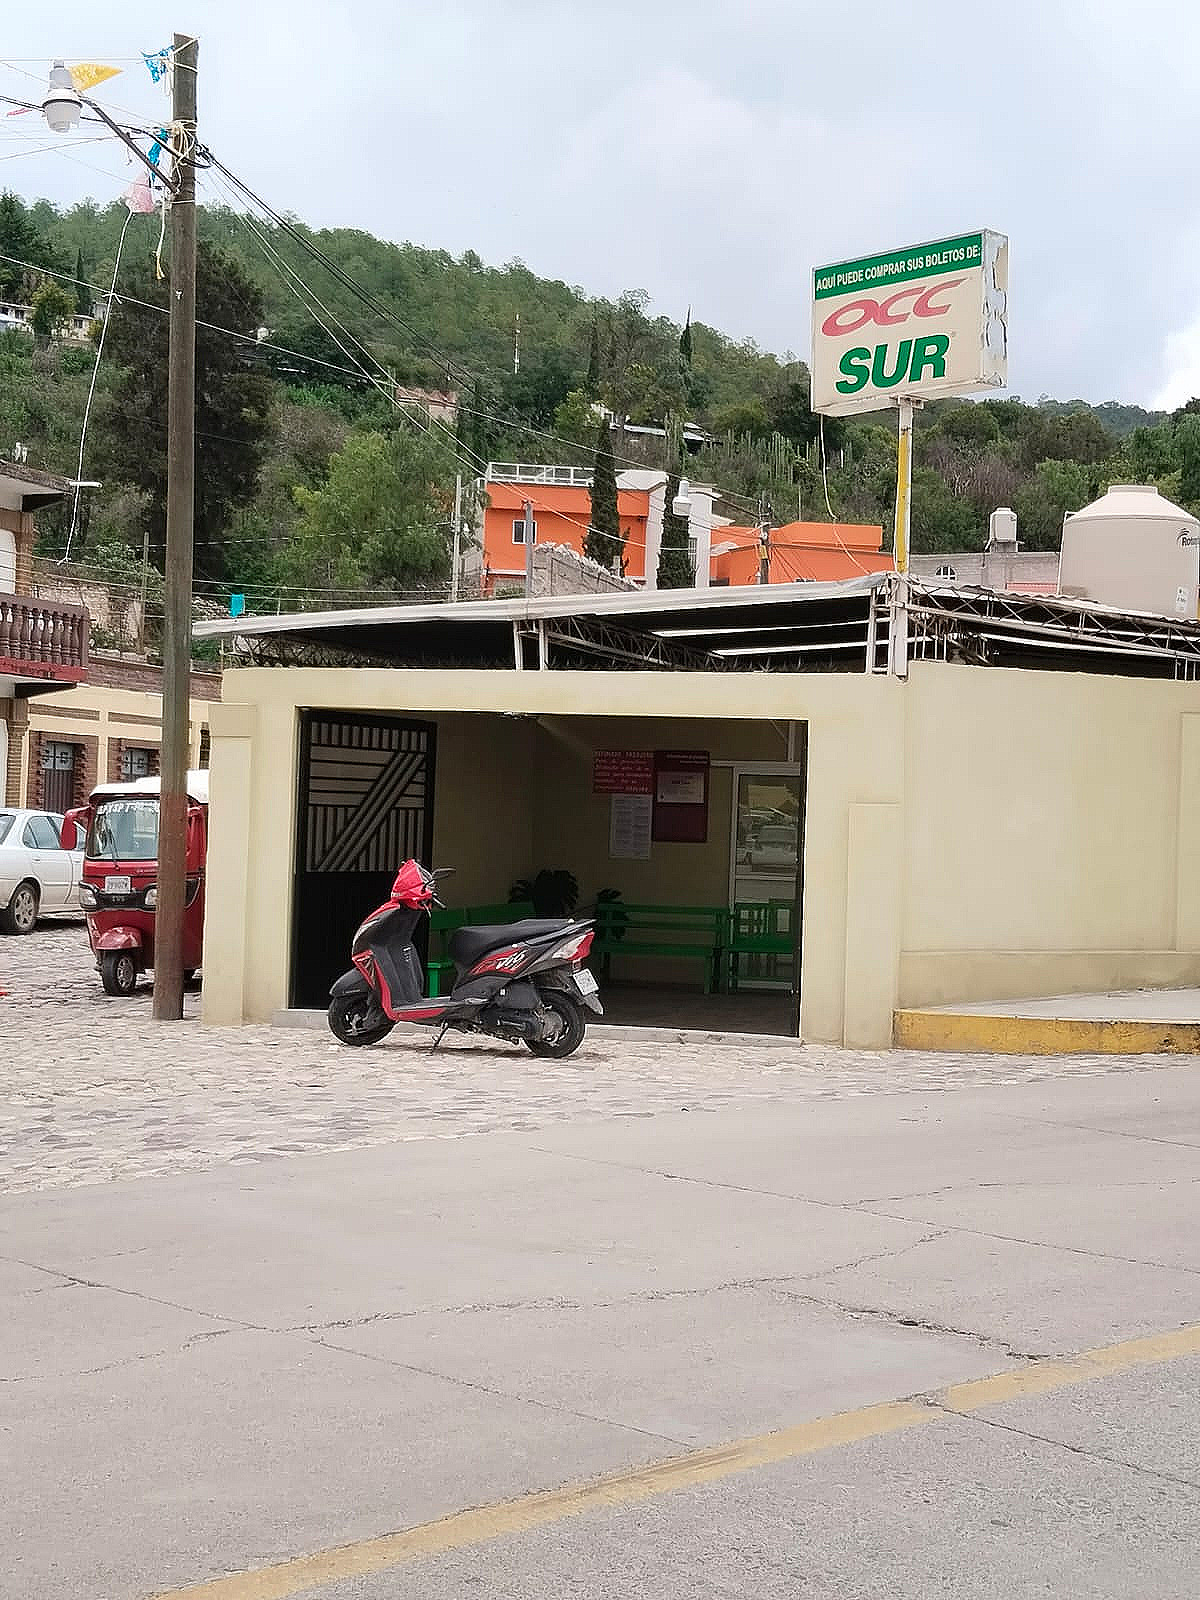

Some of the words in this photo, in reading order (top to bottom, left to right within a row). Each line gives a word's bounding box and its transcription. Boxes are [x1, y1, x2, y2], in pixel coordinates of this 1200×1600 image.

[836, 269, 864, 287] PUEDE
[864, 261, 906, 281] COMPRAR
[906, 256, 924, 271] SUS
[925, 248, 965, 267] BOLETOS
[835, 334, 950, 394] SUR
